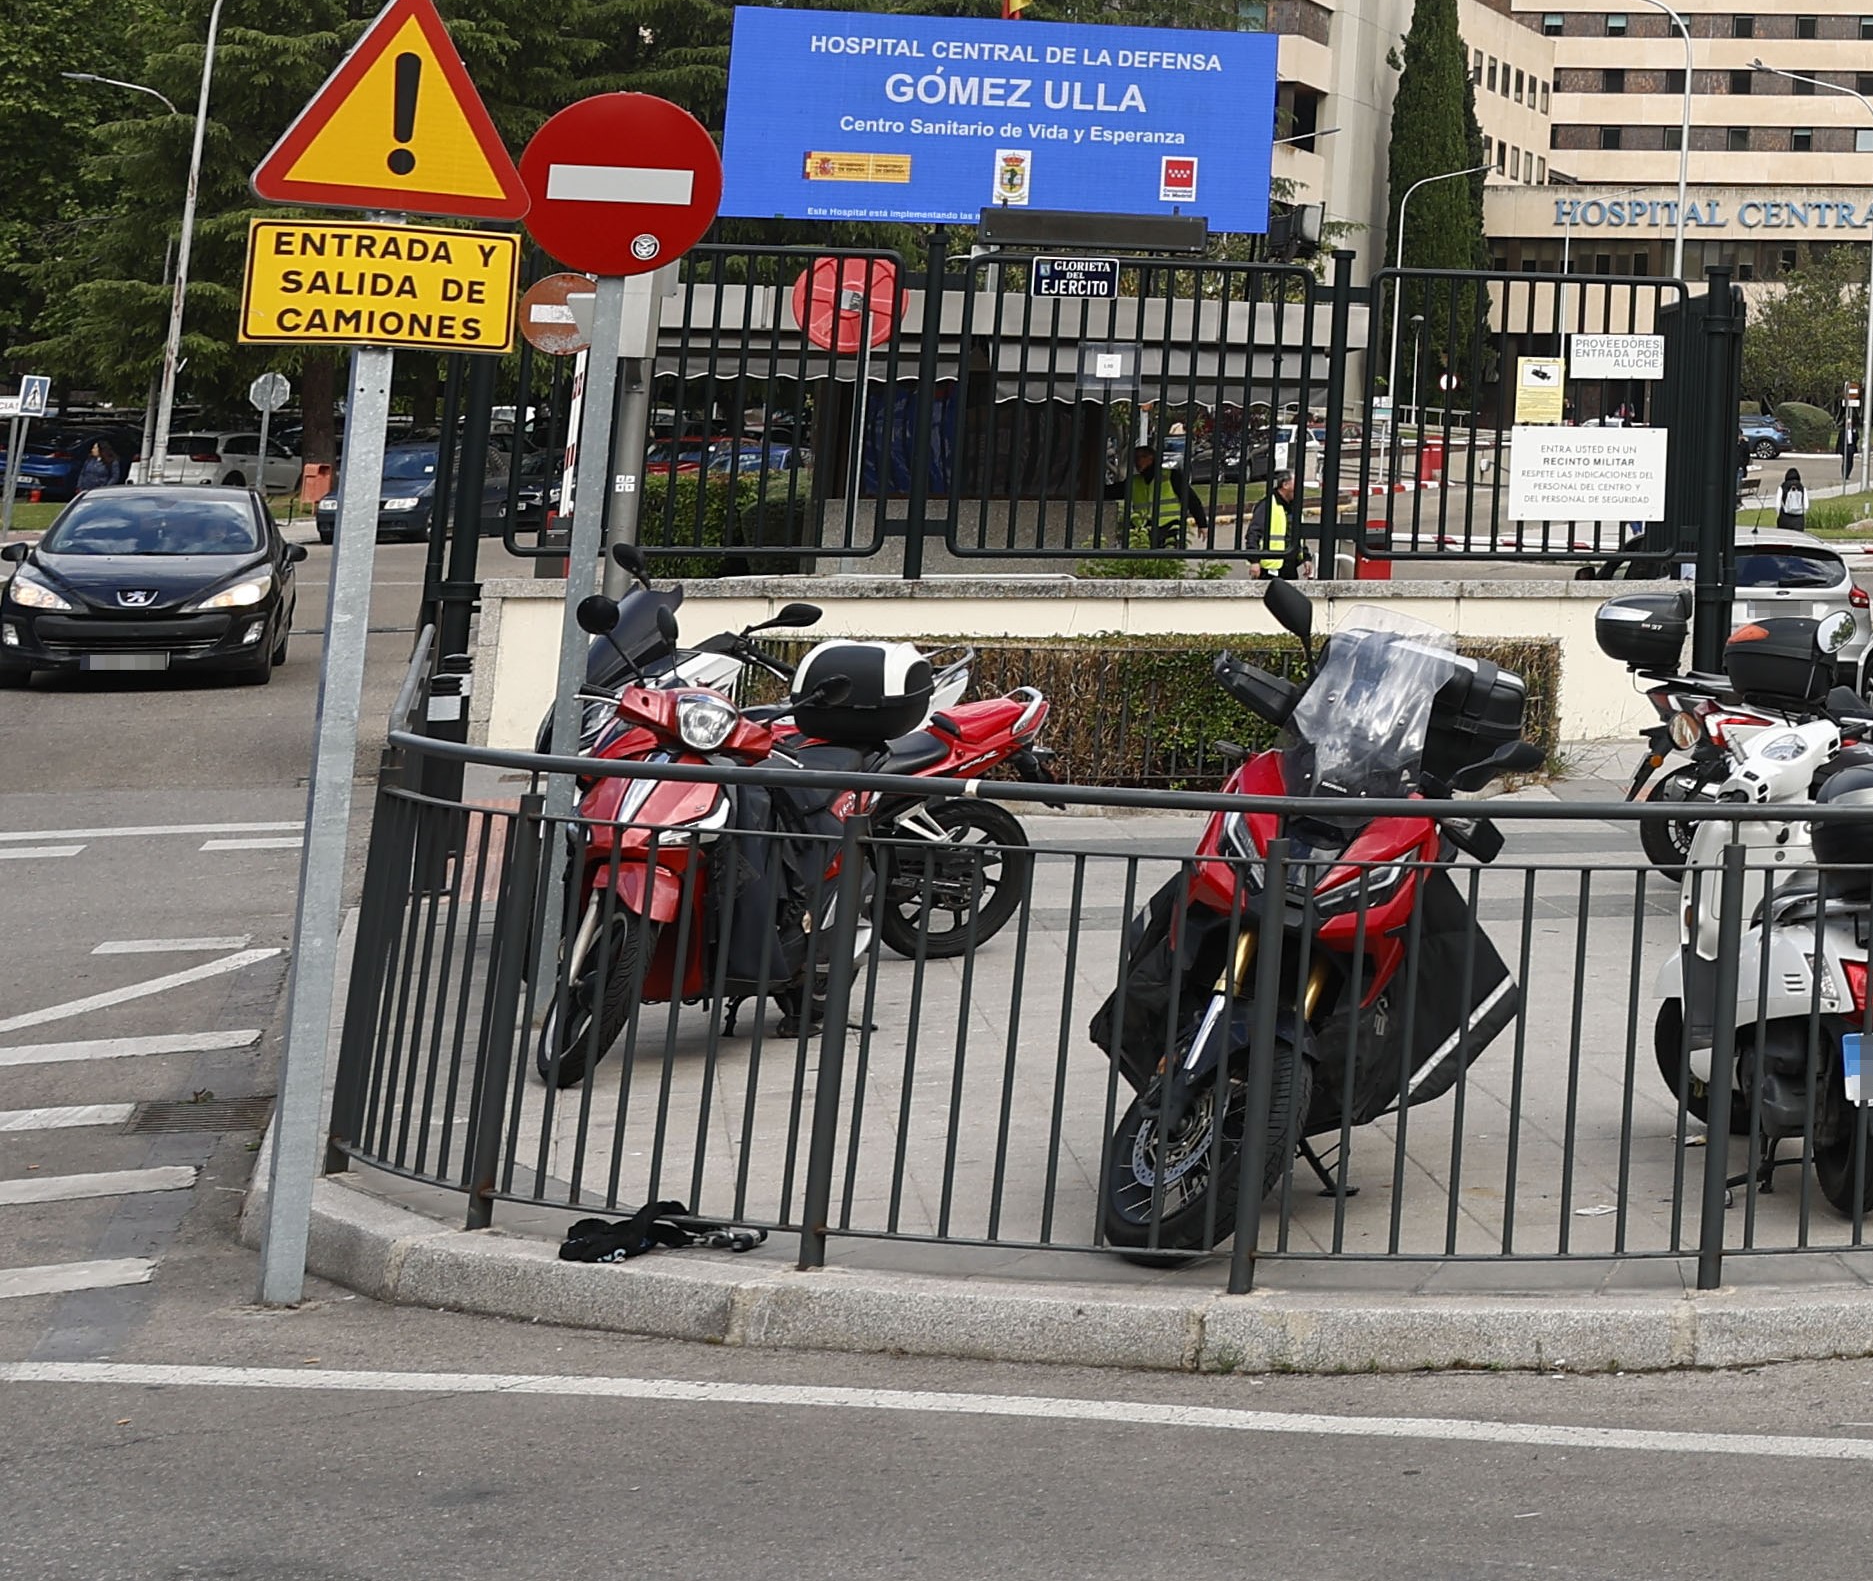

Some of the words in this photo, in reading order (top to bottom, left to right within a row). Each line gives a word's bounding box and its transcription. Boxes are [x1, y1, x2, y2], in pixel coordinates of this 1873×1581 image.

[810, 35, 925, 57] HOSPITAL
[932, 41, 1039, 63] CENTRAL
[1046, 47, 1076, 64] DE
[1083, 49, 1111, 66] LA
[1118, 50, 1222, 71] DEFENSA
[885, 66, 1032, 108] GÓMEZ
[1045, 80, 1147, 113] ULLA
[840, 116, 904, 133] Centro
[910, 119, 994, 137] Sanitario
[1000, 122, 1022, 138] de
[1028, 123, 1068, 140] Vida
[1073, 128, 1085, 142] y
[1090, 127, 1185, 145] Esperanza
[807, 208, 827, 216] Este
[830, 209, 867, 218] Hospital
[890, 211, 958, 219] implementando
[1554, 198, 1727, 228] HOSPITAL
[274, 231, 453, 264] ENTRADA
[478, 244, 497, 268] Y
[1054, 261, 1111, 272] GLORIETA
[280, 270, 418, 299] SALIDA
[441, 278, 486, 304] DE
[1041, 279, 1108, 295] EJERCITO
[276, 307, 481, 340] CAMIONES
[1576, 339, 1660, 349] PROVEEDORES
[1576, 349, 1629, 358] ENTRADA
[1637, 350, 1659, 358] POR
[1613, 359, 1659, 368] ALUCHE
[1541, 445, 1571, 453] ENTRA
[1543, 458, 1590, 466] RECINTO
[1593, 458, 1635, 466] MILITAR
[1575, 471, 1637, 479] INDICACIONES
[1639, 471, 1653, 479] DEL
[1533, 482, 1577, 490] PERSONAL
[1542, 495, 1585, 503] PERSONAL
